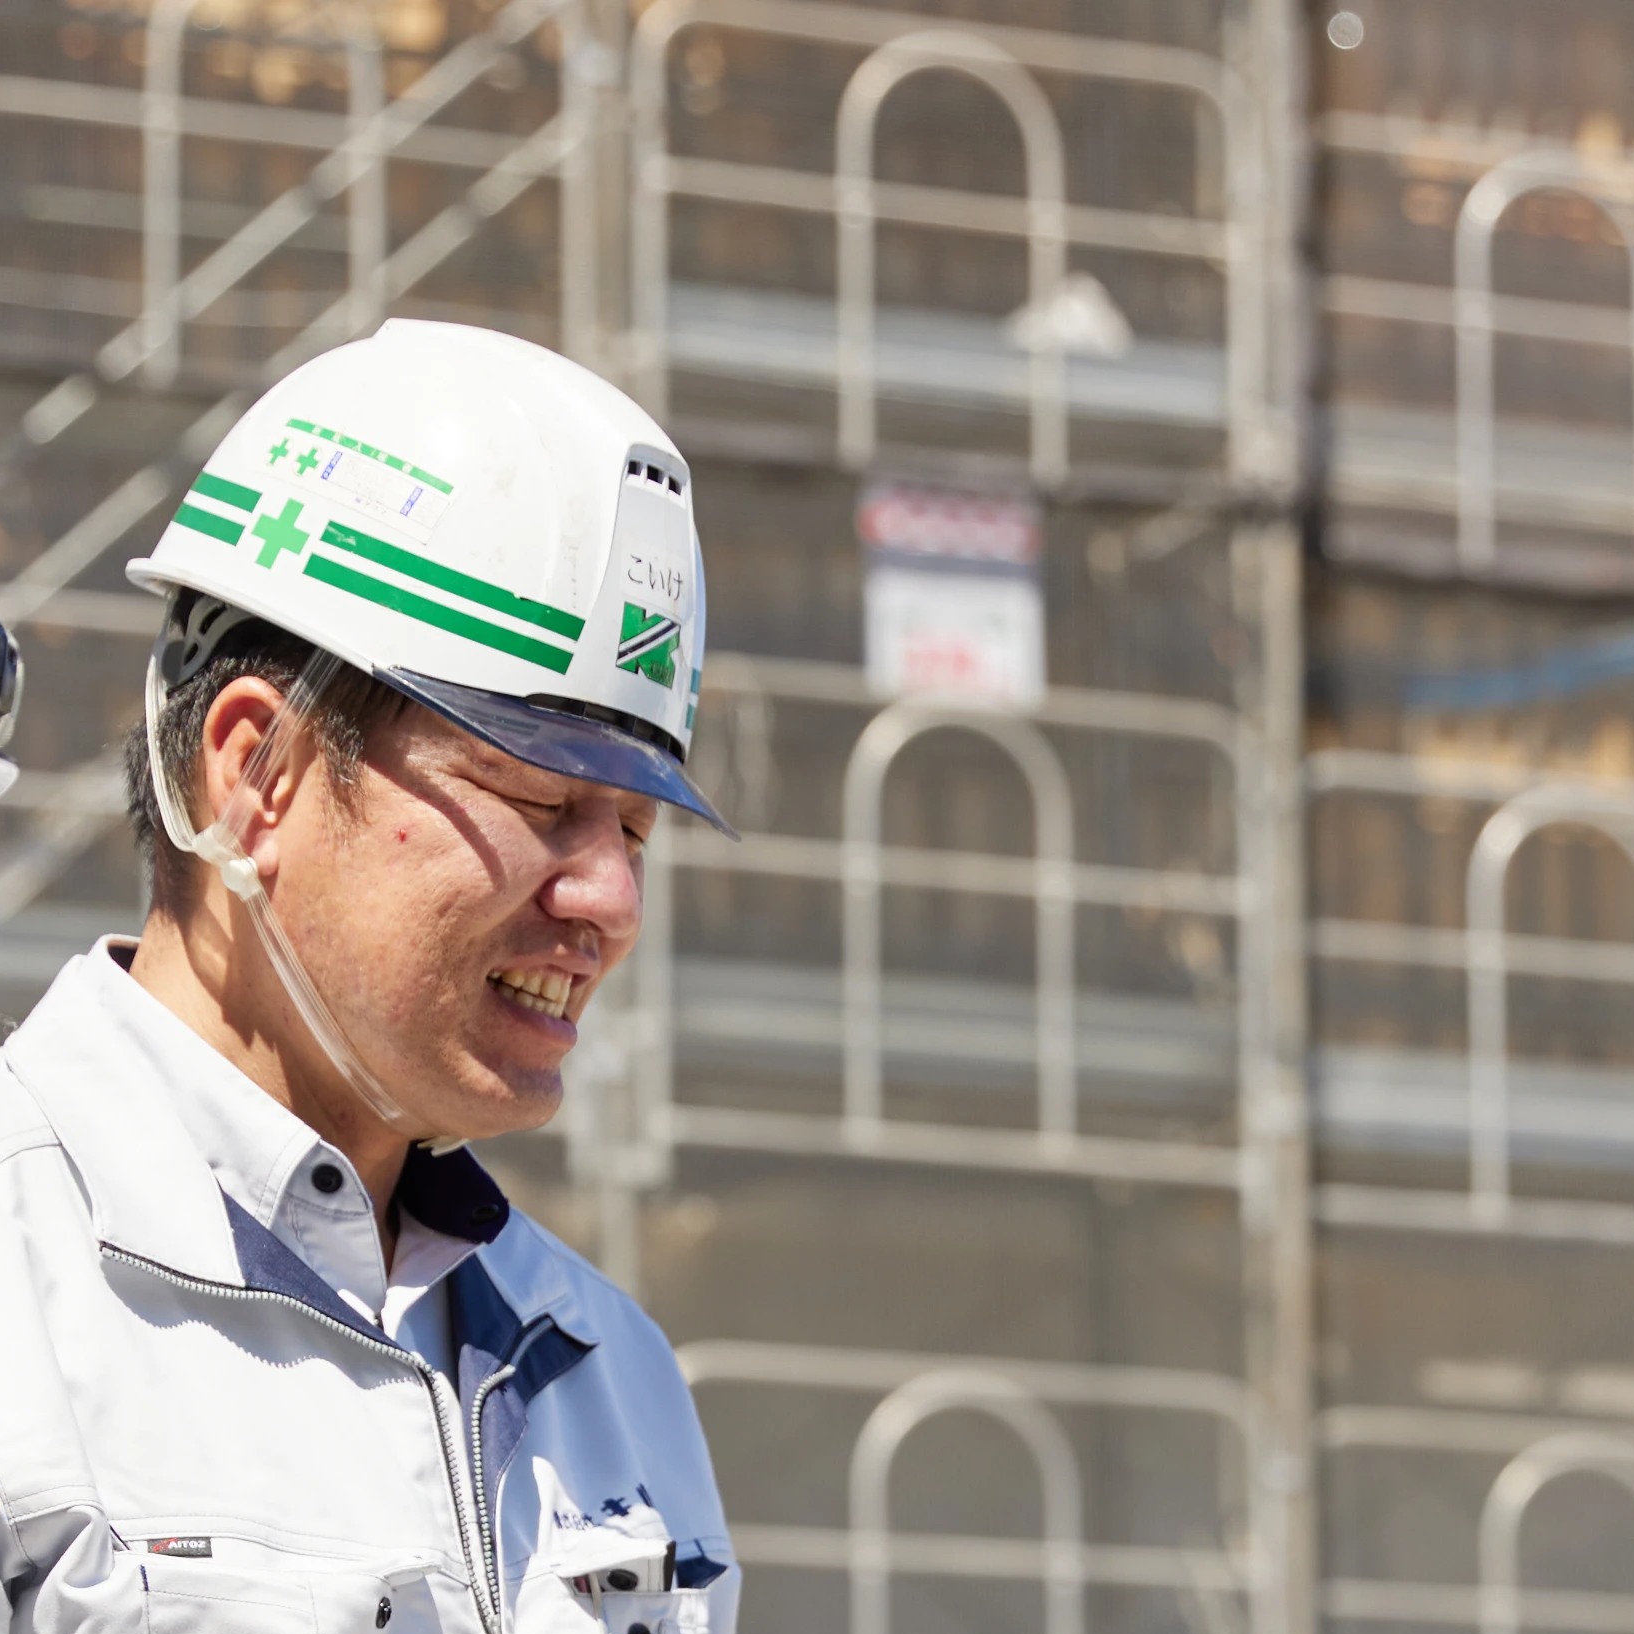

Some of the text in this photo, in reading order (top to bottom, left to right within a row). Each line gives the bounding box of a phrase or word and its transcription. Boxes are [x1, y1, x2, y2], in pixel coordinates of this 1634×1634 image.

[627, 554, 684, 600] こいけ
[168, 1541, 206, 1549] AITOZ
